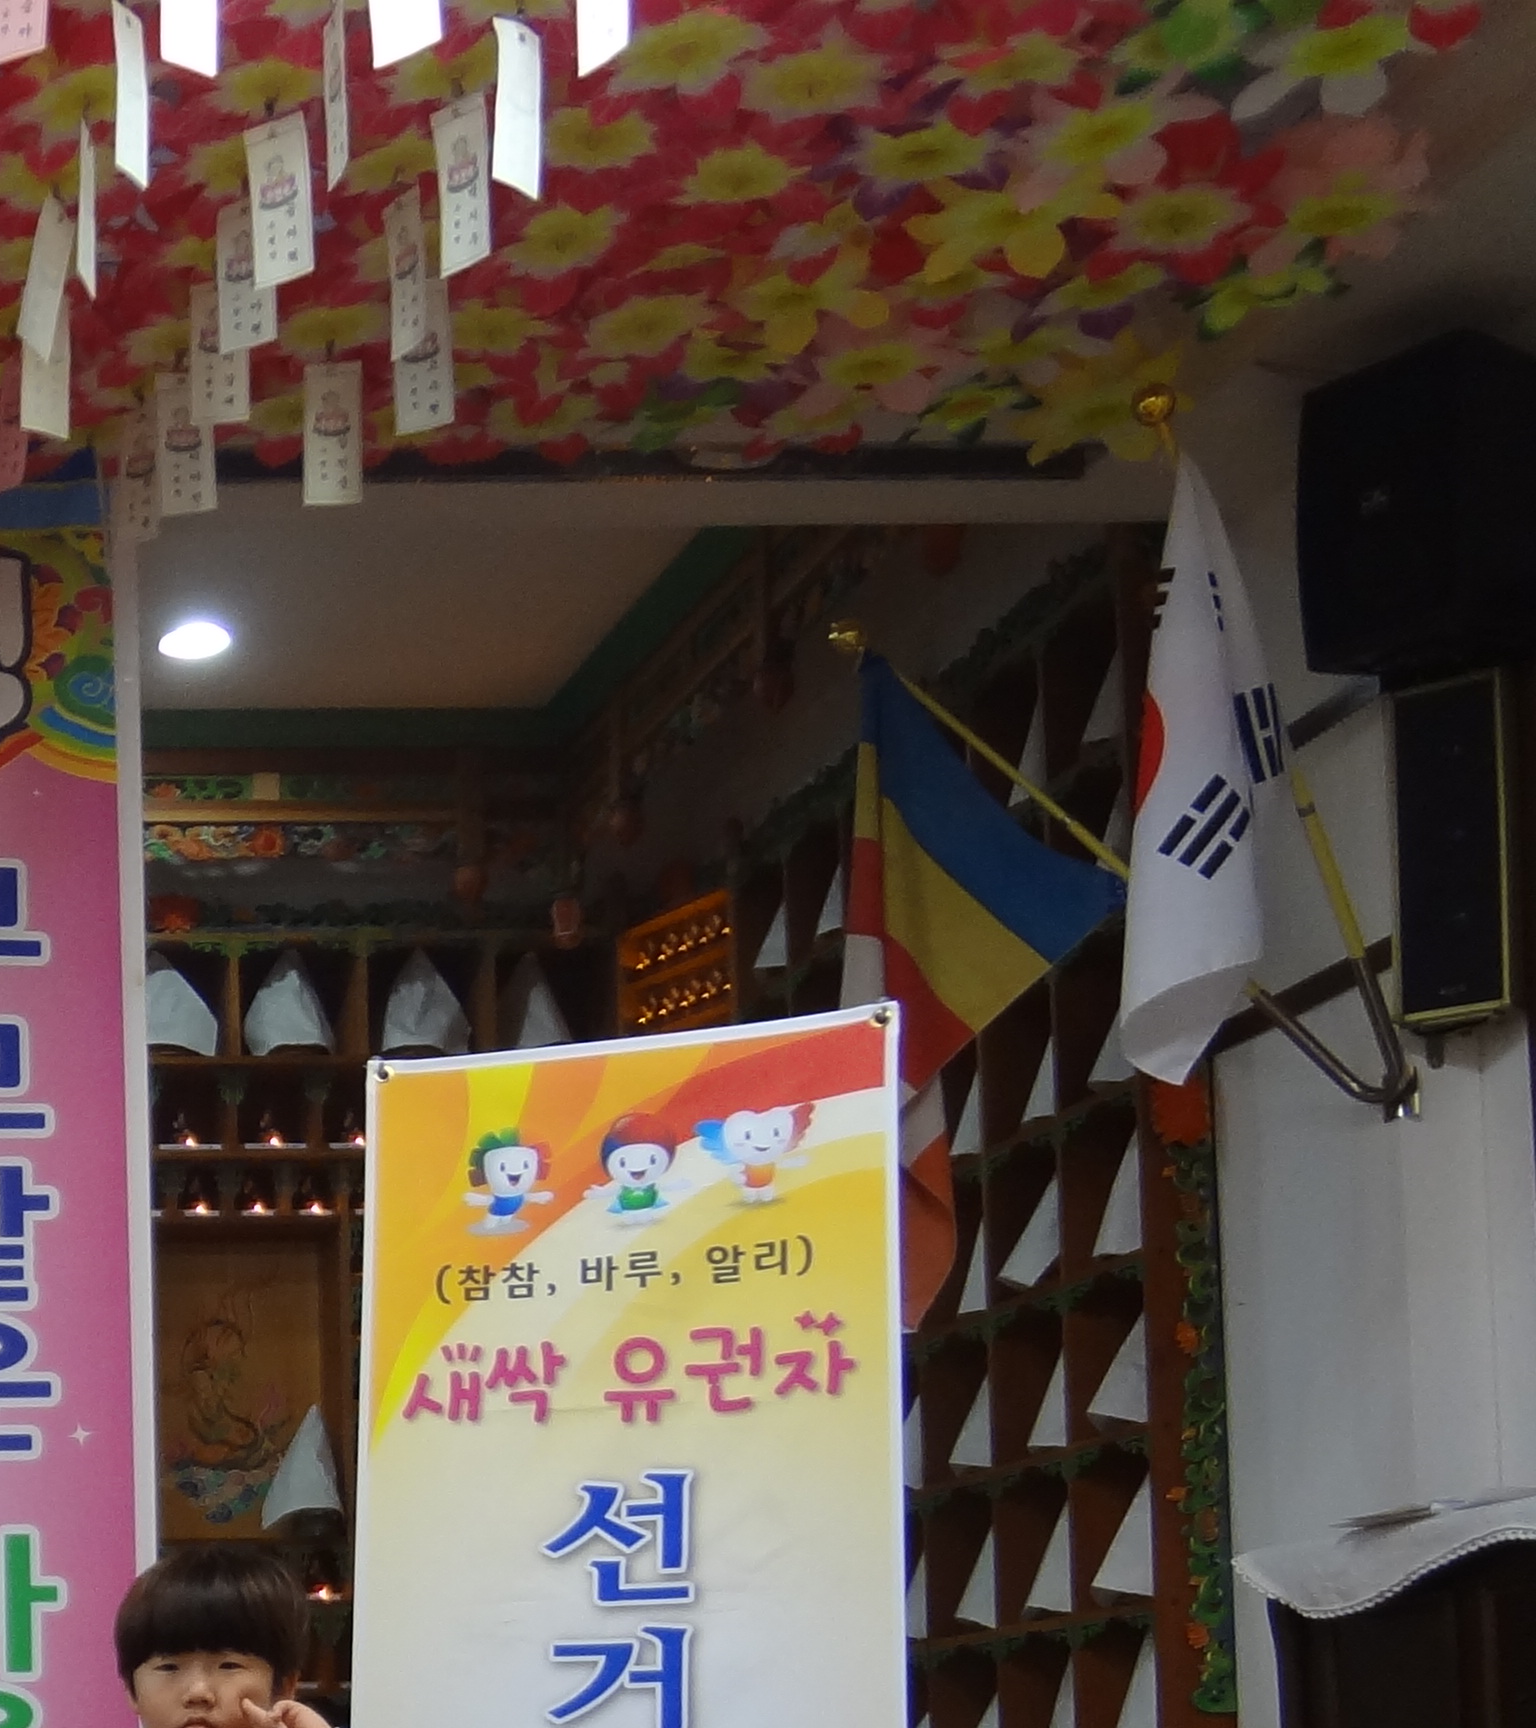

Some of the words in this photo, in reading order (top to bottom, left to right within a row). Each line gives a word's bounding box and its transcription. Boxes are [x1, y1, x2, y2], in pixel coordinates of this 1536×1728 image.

[434, 1260, 559, 1306] (참참,
[579, 1250, 682, 1294] 바루,
[705, 1233, 815, 1287] 알리)
[401, 1341, 569, 1425] 새싹
[603, 1312, 858, 1425] 유권자
